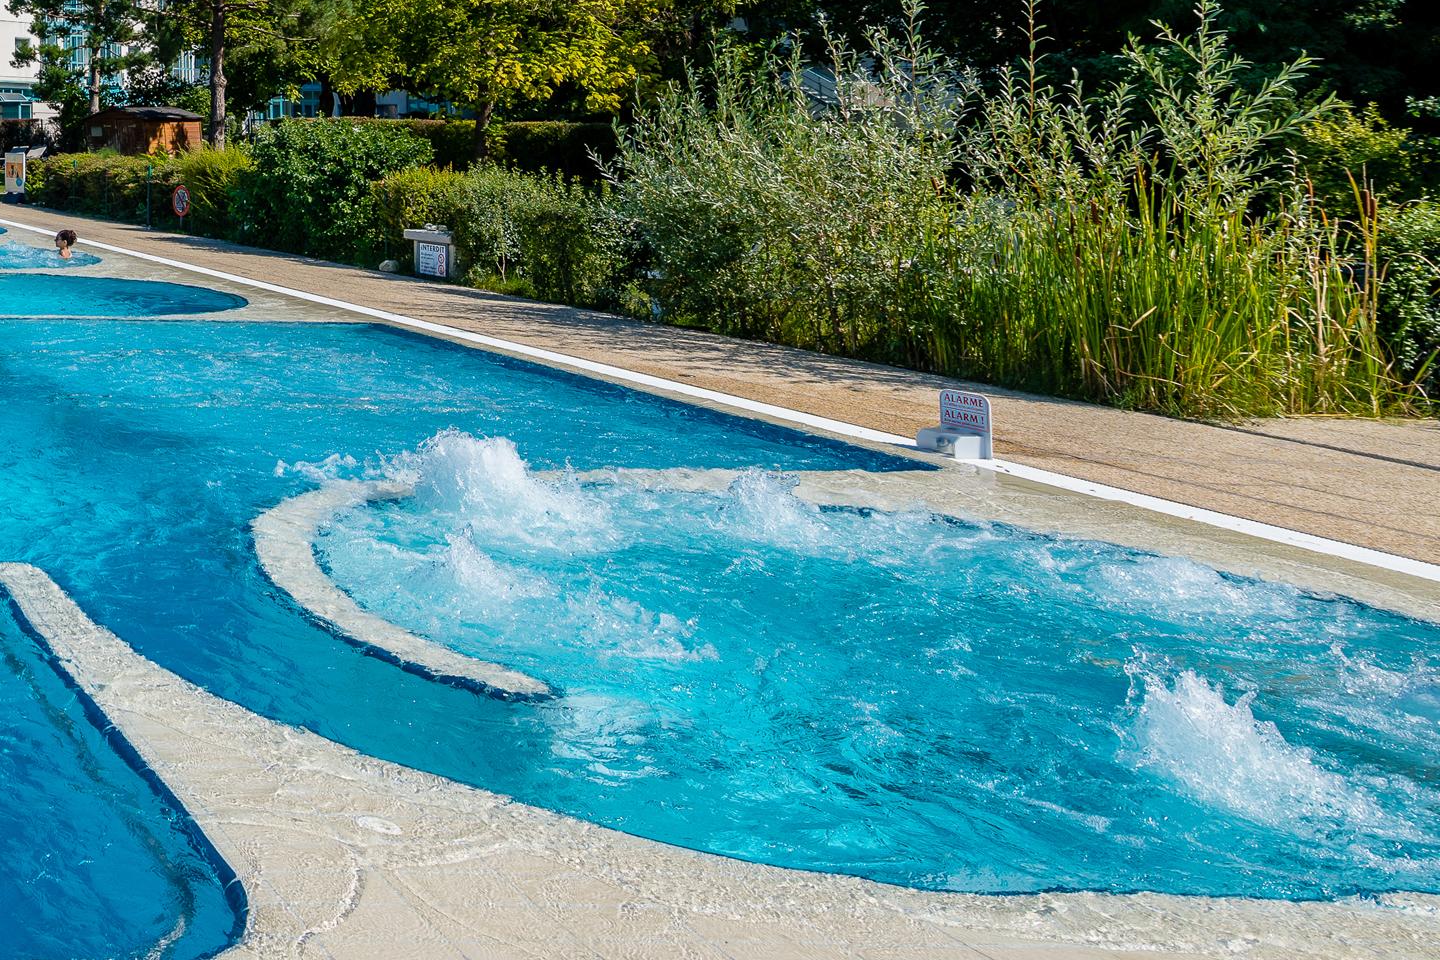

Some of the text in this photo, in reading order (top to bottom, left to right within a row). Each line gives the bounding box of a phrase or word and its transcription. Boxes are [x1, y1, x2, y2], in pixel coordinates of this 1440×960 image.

[421, 245, 444, 253] INTERDIT
[944, 393, 983, 407] ALARME
[944, 409, 978, 423] ALARM
